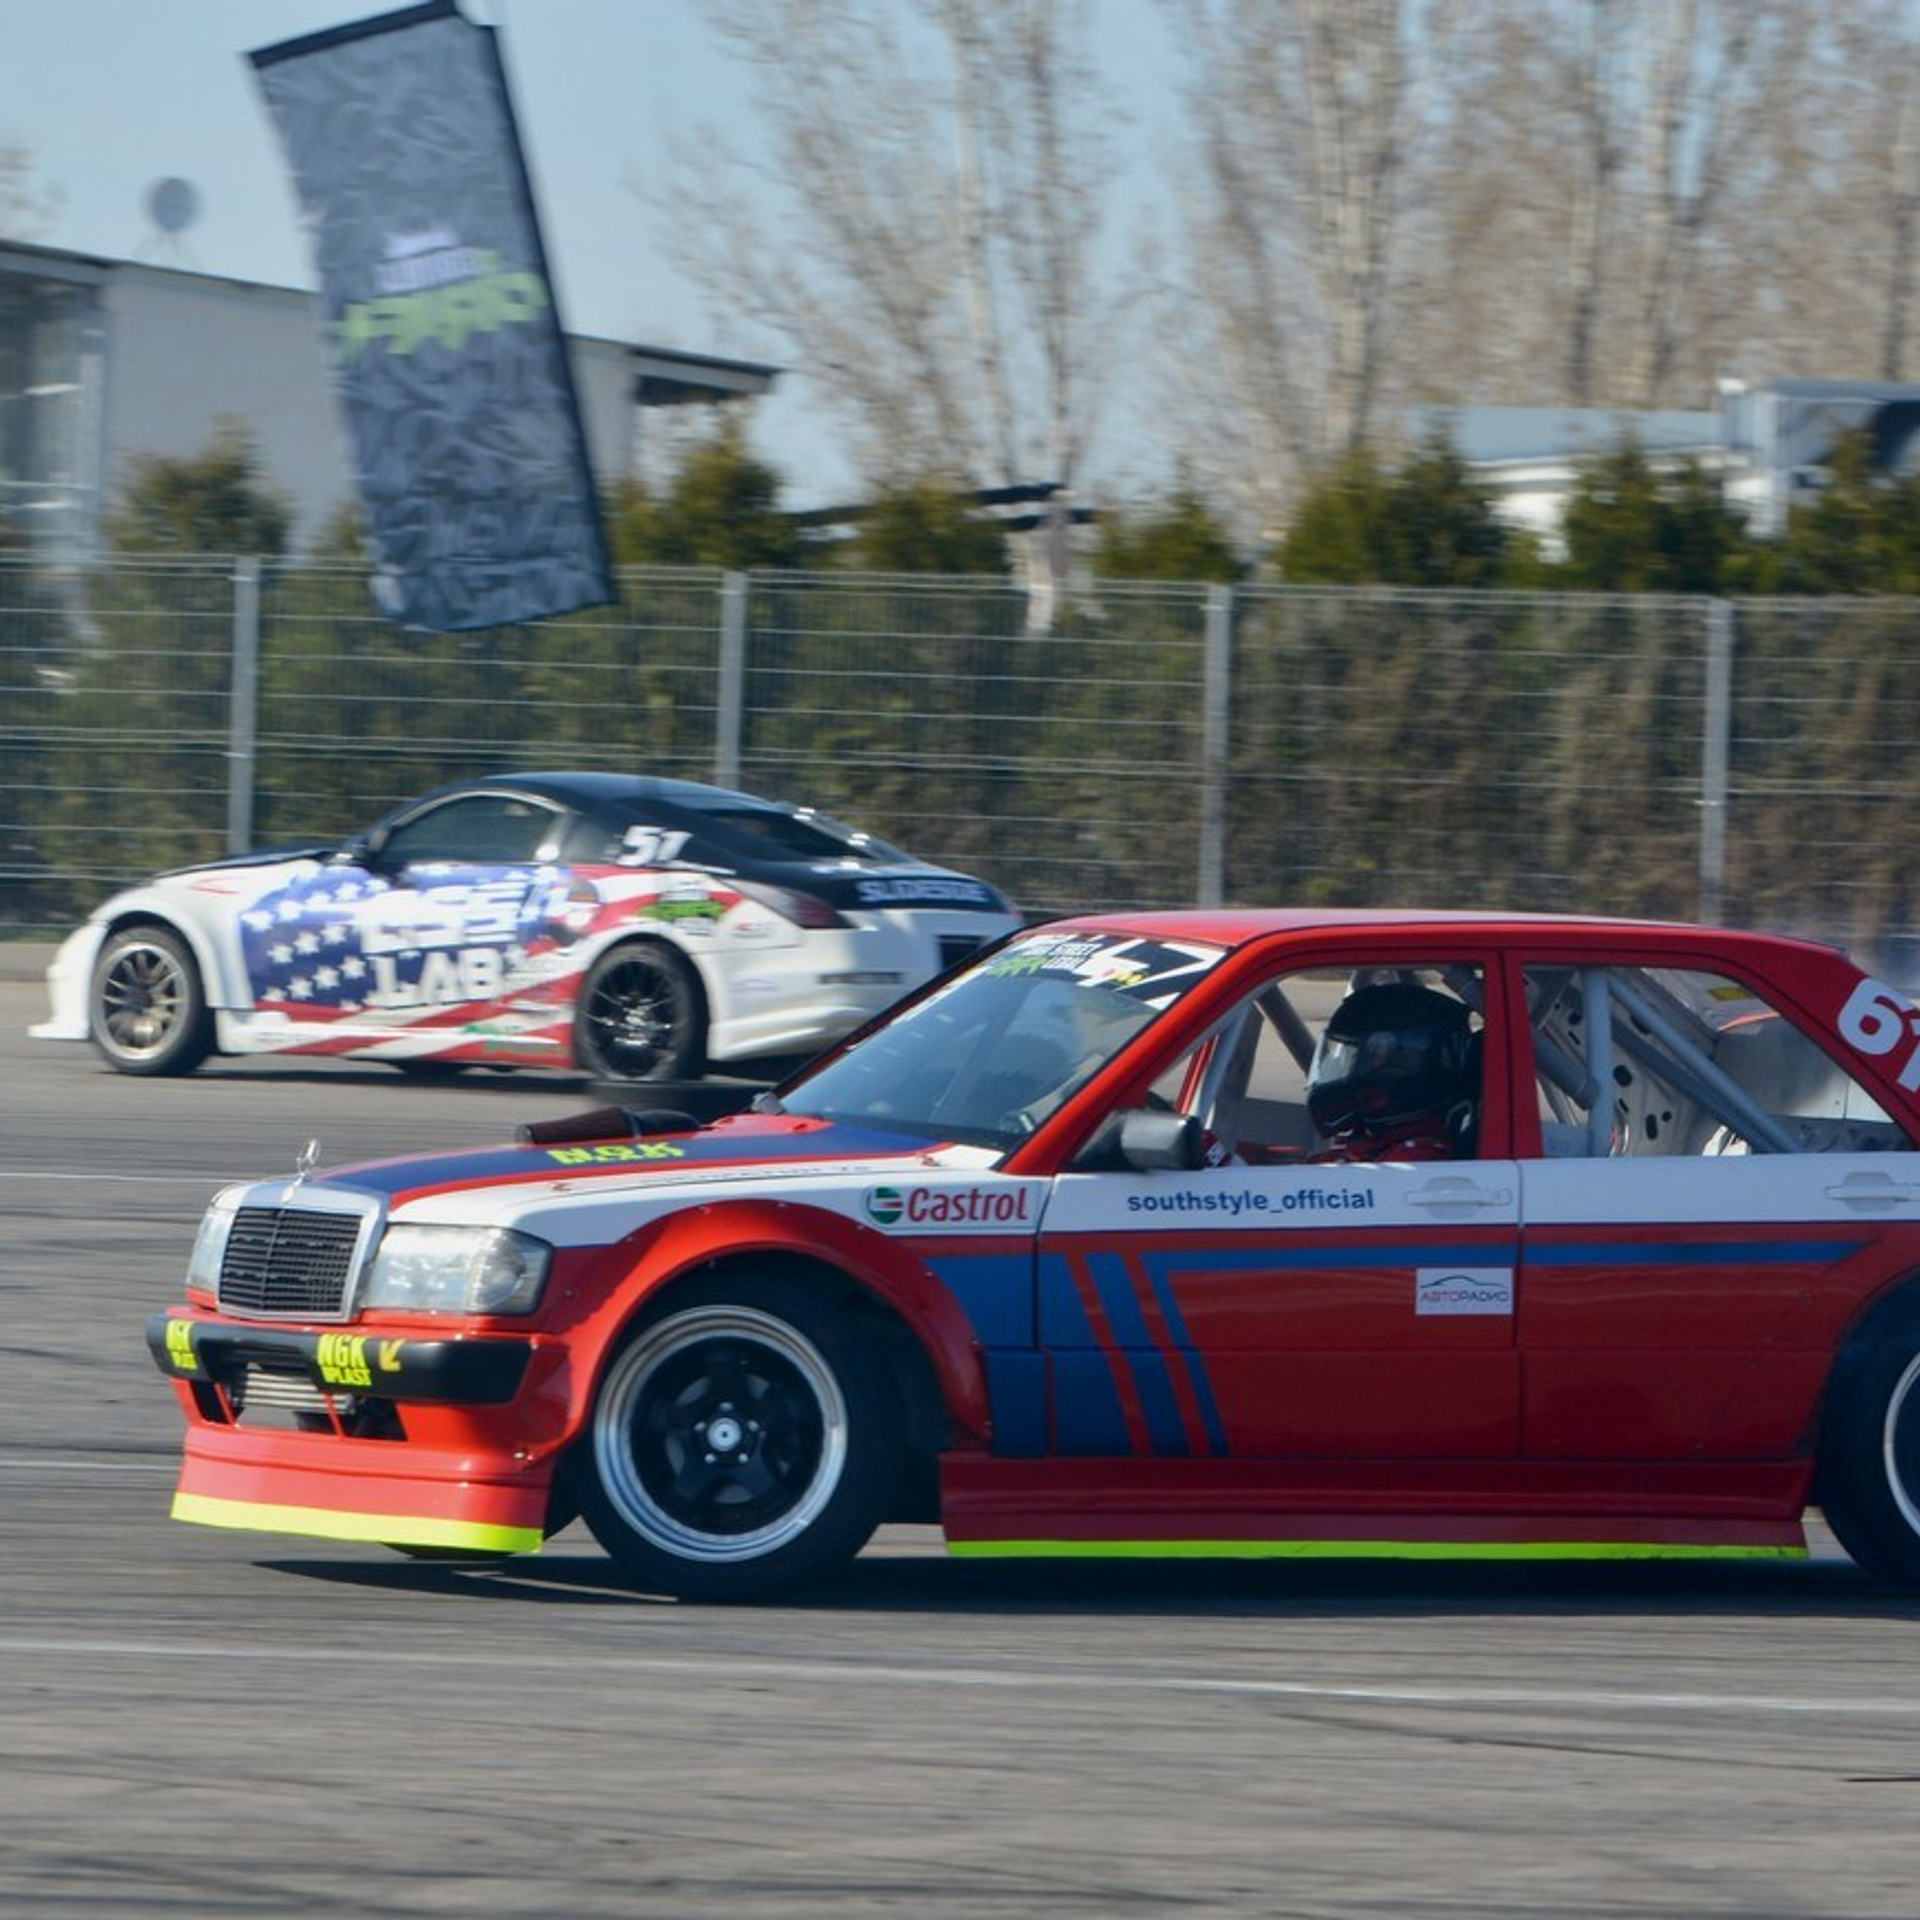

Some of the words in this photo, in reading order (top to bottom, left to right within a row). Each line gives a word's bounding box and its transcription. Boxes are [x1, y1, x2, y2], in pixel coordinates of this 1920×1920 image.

[368, 948, 504, 1006] LAB
[907, 1186, 1029, 1222] Castrol
[1127, 1188, 1374, 1216] southstyle_official
[317, 1333, 367, 1368] NGK
